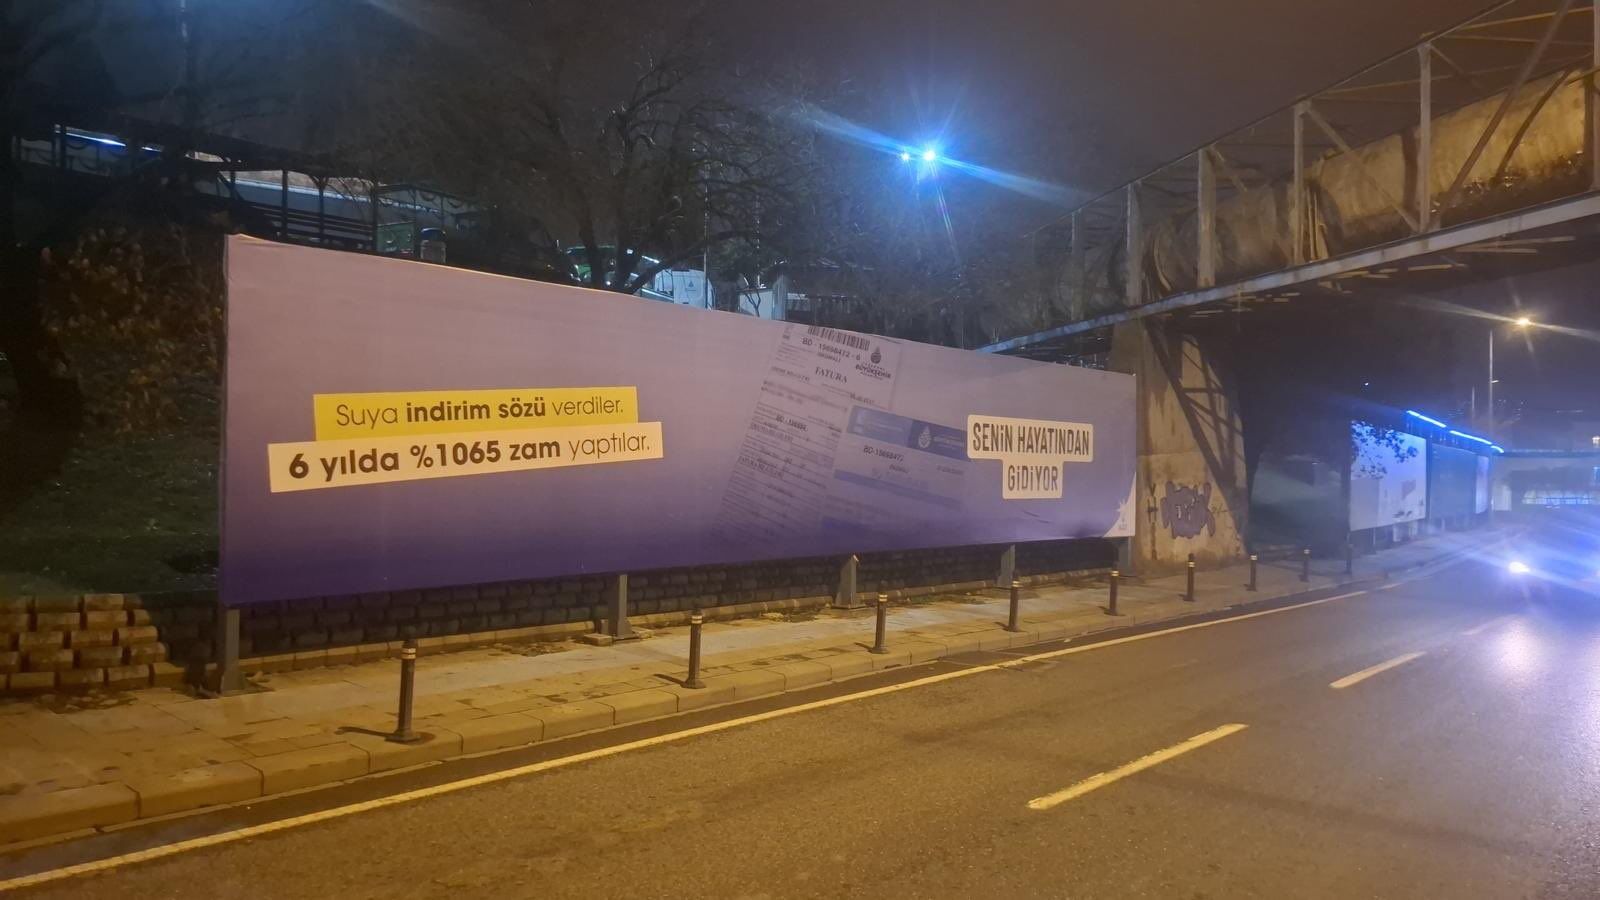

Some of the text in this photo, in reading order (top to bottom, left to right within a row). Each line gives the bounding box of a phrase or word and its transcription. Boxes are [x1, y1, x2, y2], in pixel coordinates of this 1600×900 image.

[815, 366, 848, 383] FATURA
[336, 395, 624, 430] Suya indirim sözü verdiler.
[288, 431, 650, 482] 6 yılda %1065 zam yaptılar.
[1017, 426, 1090, 456] HAYATINDAN
